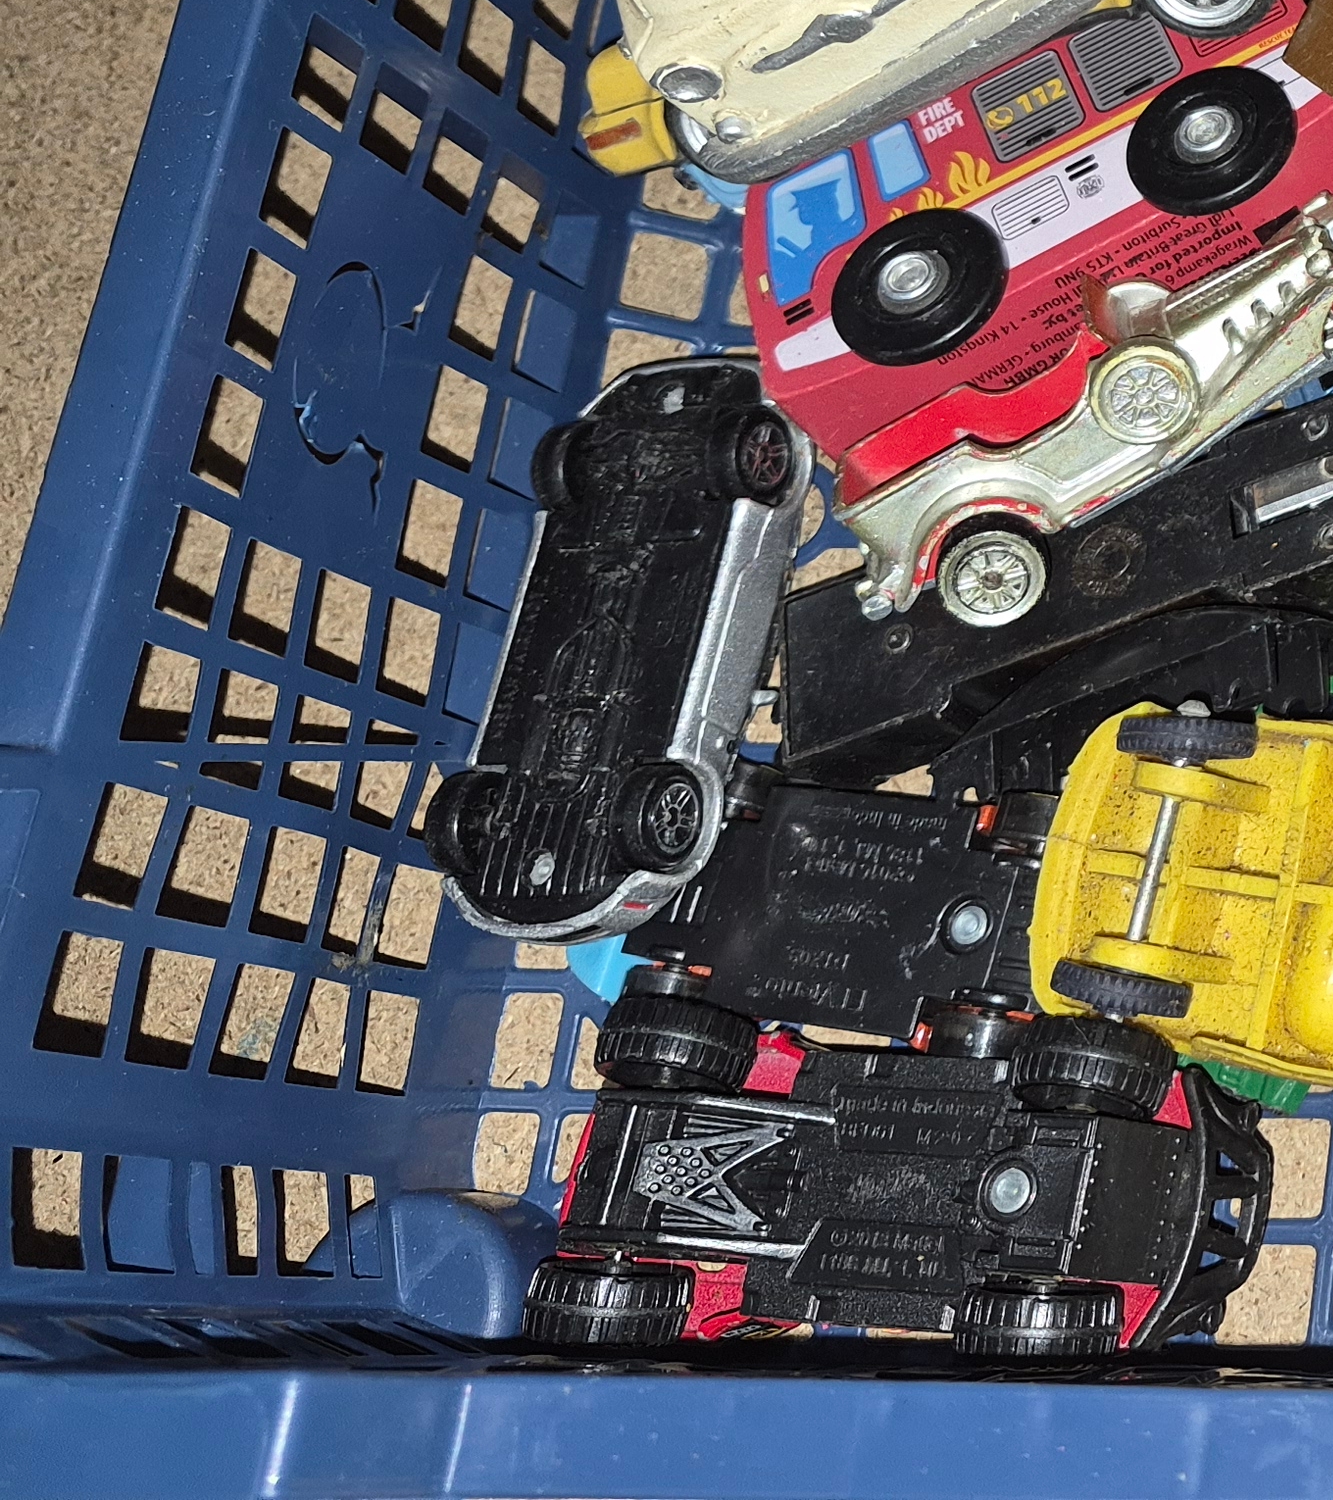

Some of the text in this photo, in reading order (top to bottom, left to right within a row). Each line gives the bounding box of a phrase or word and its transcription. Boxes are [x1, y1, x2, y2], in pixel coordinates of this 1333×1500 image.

[917, 95, 954, 127] FIRE
[1015, 76, 1069, 116] 112
[922, 107, 968, 145] DEPT
[1205, 204, 1234, 228] Lidl
[1120, 214, 1181, 254] Surbiton
[1168, 219, 1207, 247] Great
[1168, 217, 1243, 266] Imported
[1123, 239, 1170, 271] Britain
[1146, 256, 1172, 278] for
[1172, 231, 1251, 281] Wragekamp
[1052, 264, 1085, 290] 9NU
[1162, 272, 1176, 286] 6
[1027, 289, 1072, 322] House
[999, 318, 1019, 336] 14
[931, 324, 1000, 372] Kingston
